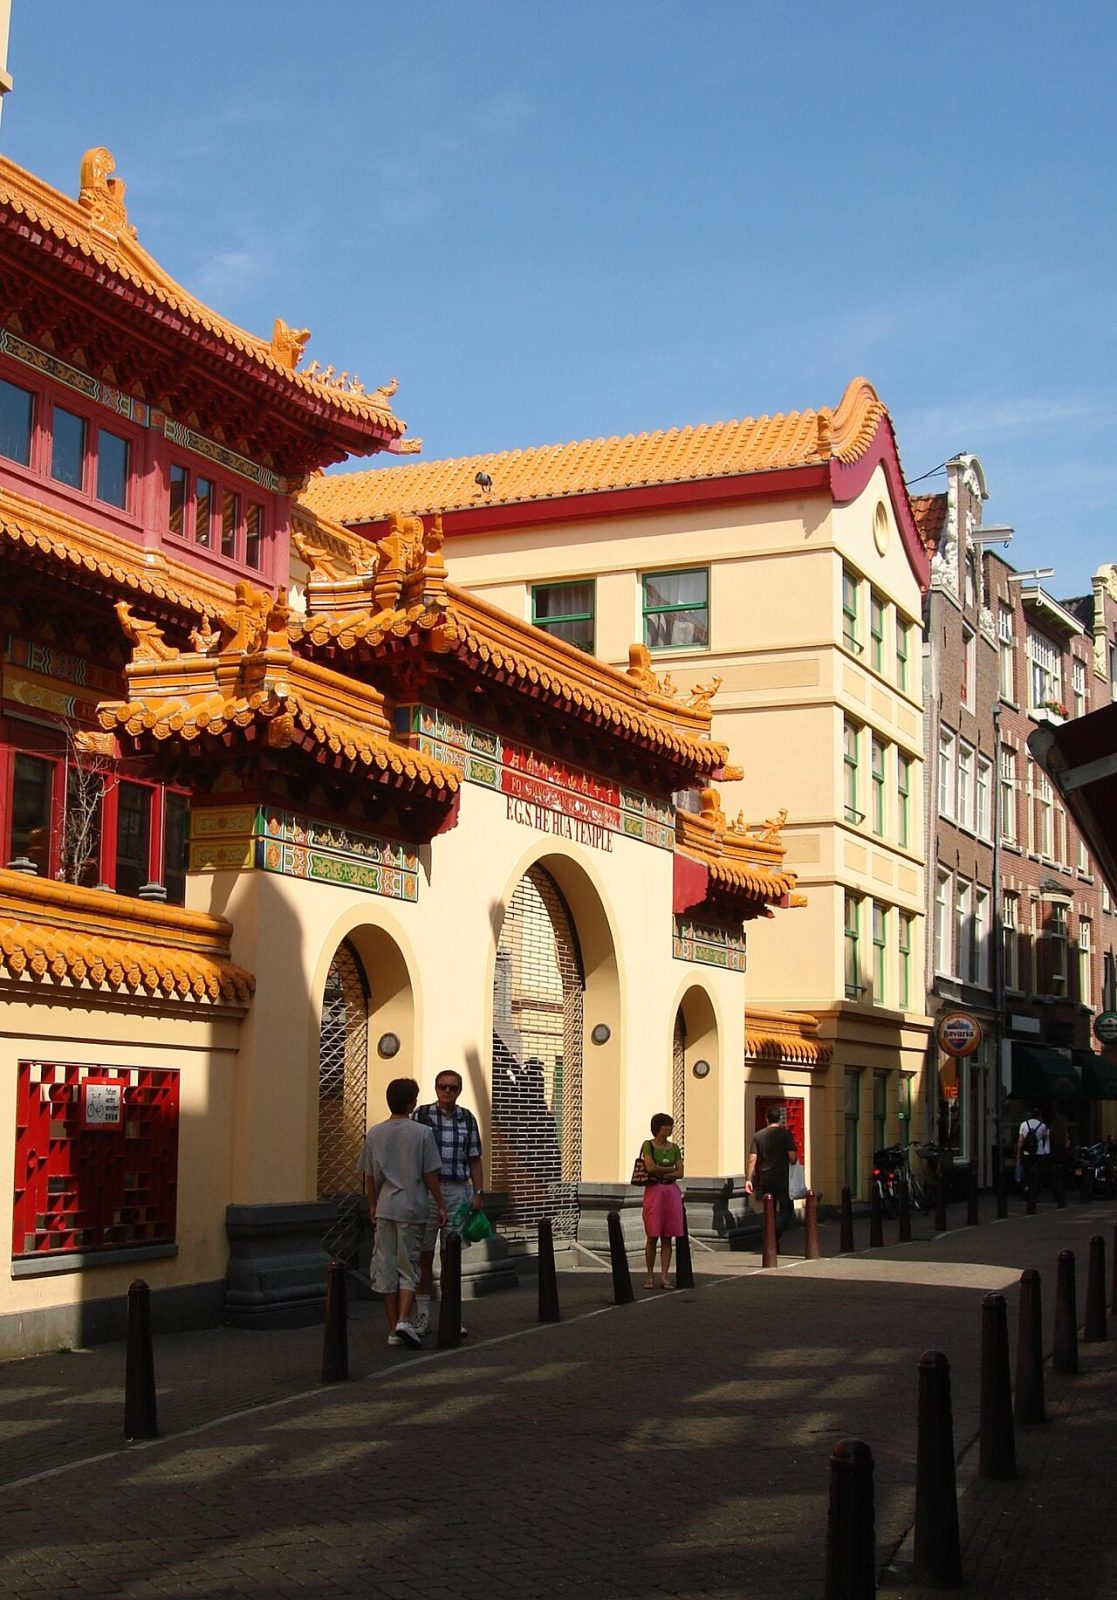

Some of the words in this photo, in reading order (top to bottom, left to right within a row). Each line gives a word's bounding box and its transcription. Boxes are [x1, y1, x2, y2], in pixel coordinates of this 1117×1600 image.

[535, 805, 550, 833] HE
[552, 812, 572, 840] HUA
[573, 818, 612, 852] TEMPLE
[943, 1030, 974, 1038] Bavaria
